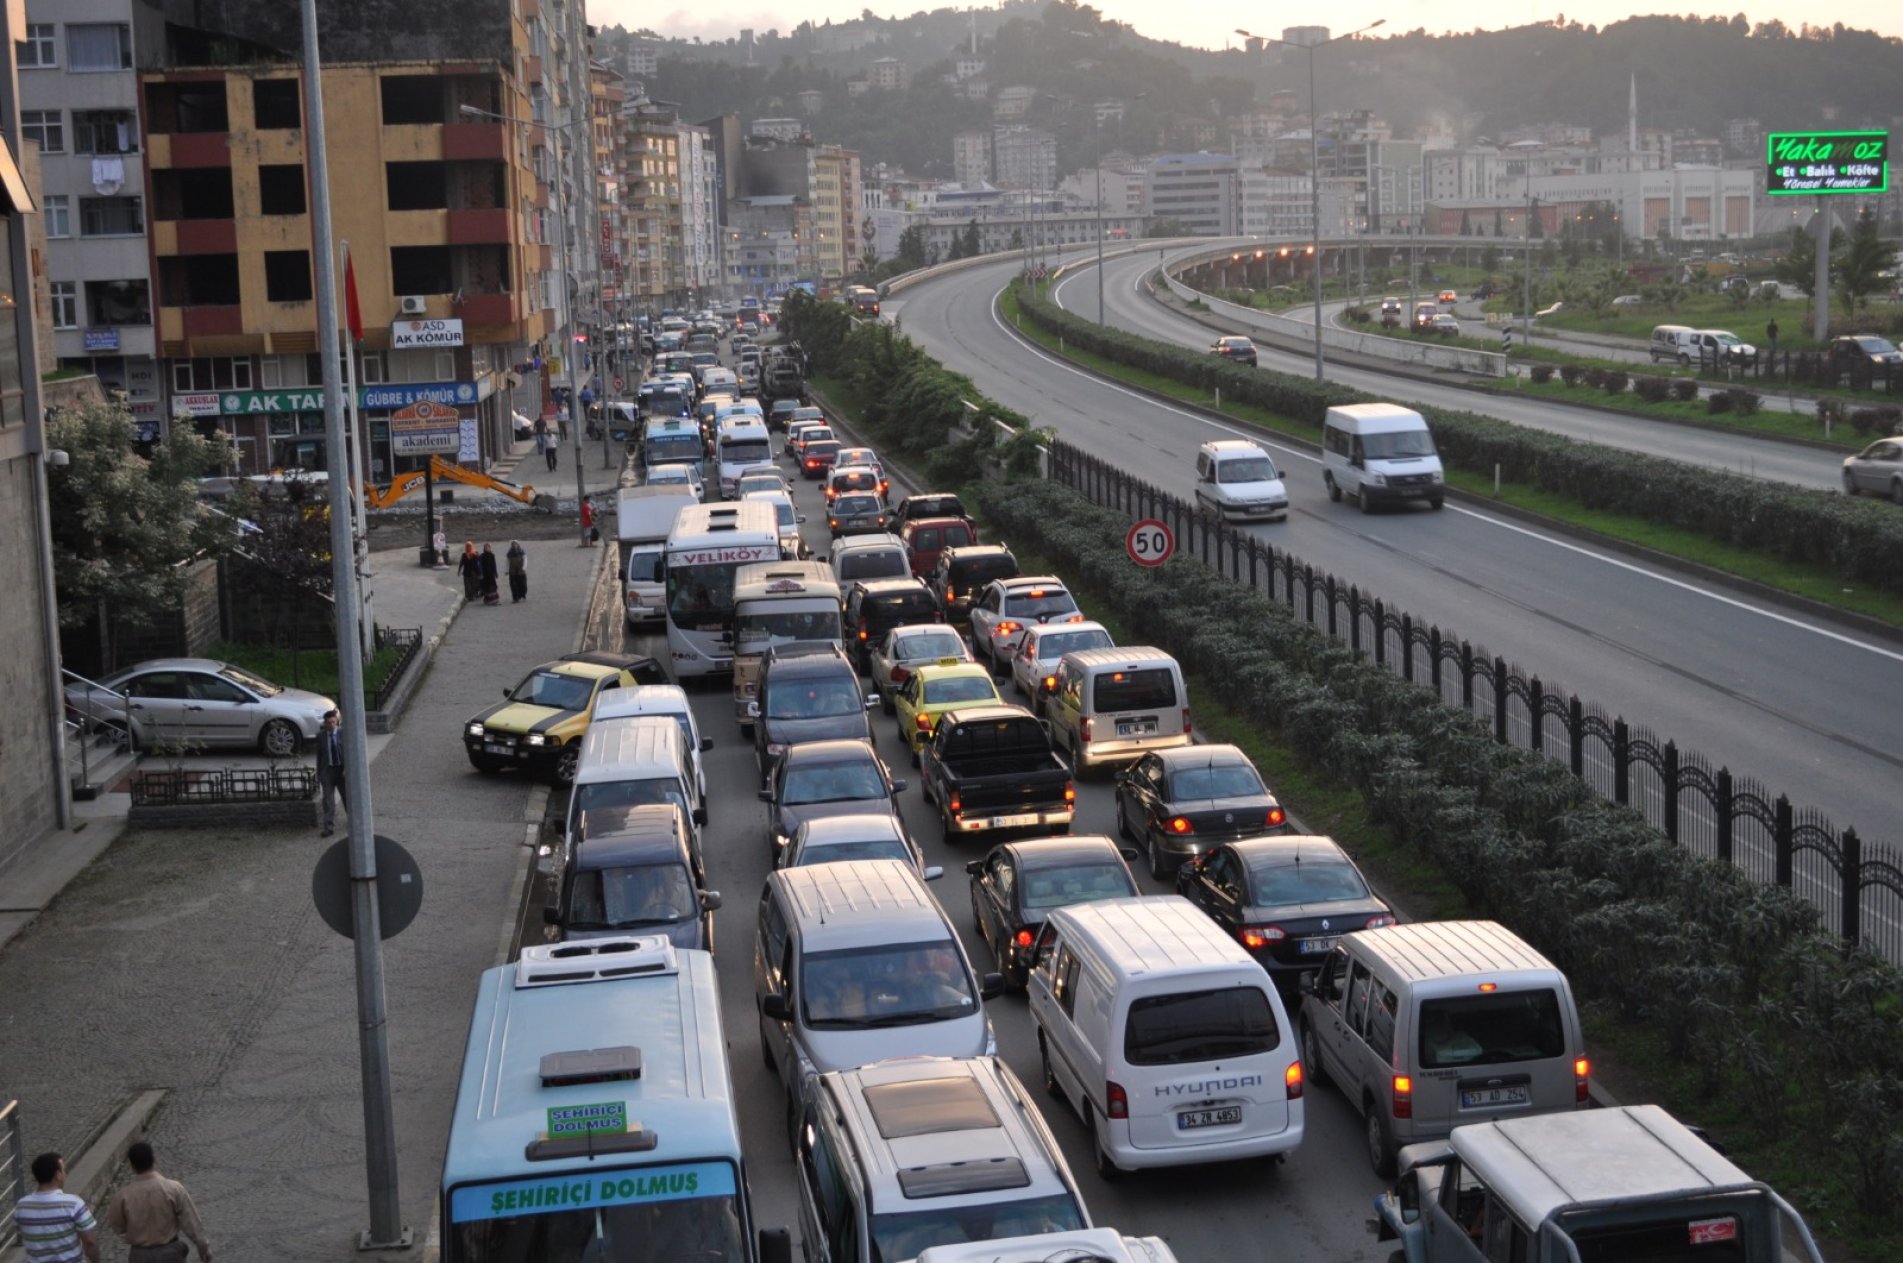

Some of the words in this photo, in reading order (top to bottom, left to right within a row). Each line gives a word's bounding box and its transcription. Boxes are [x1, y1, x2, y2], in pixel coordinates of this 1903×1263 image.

[1782, 166, 1796, 177] Et
[1847, 164, 1879, 176] Köfte
[396, 335, 412, 344] AK
[416, 330, 462, 343] KÖMÜR
[248, 395, 280, 412] AK
[366, 391, 403, 406] GÜBRE
[406, 392, 414, 404] &
[402, 435, 452, 447] akademi
[403, 476, 425, 491] JCB
[1136, 532, 1165, 554] 50
[1155, 1075, 1262, 1096] HYUNDAI
[554, 1119, 622, 1132] DOLMUŞ
[490, 1179, 592, 1214] ŞEHİRİÇİ
[600, 1172, 698, 1198] DOLMUŞ
